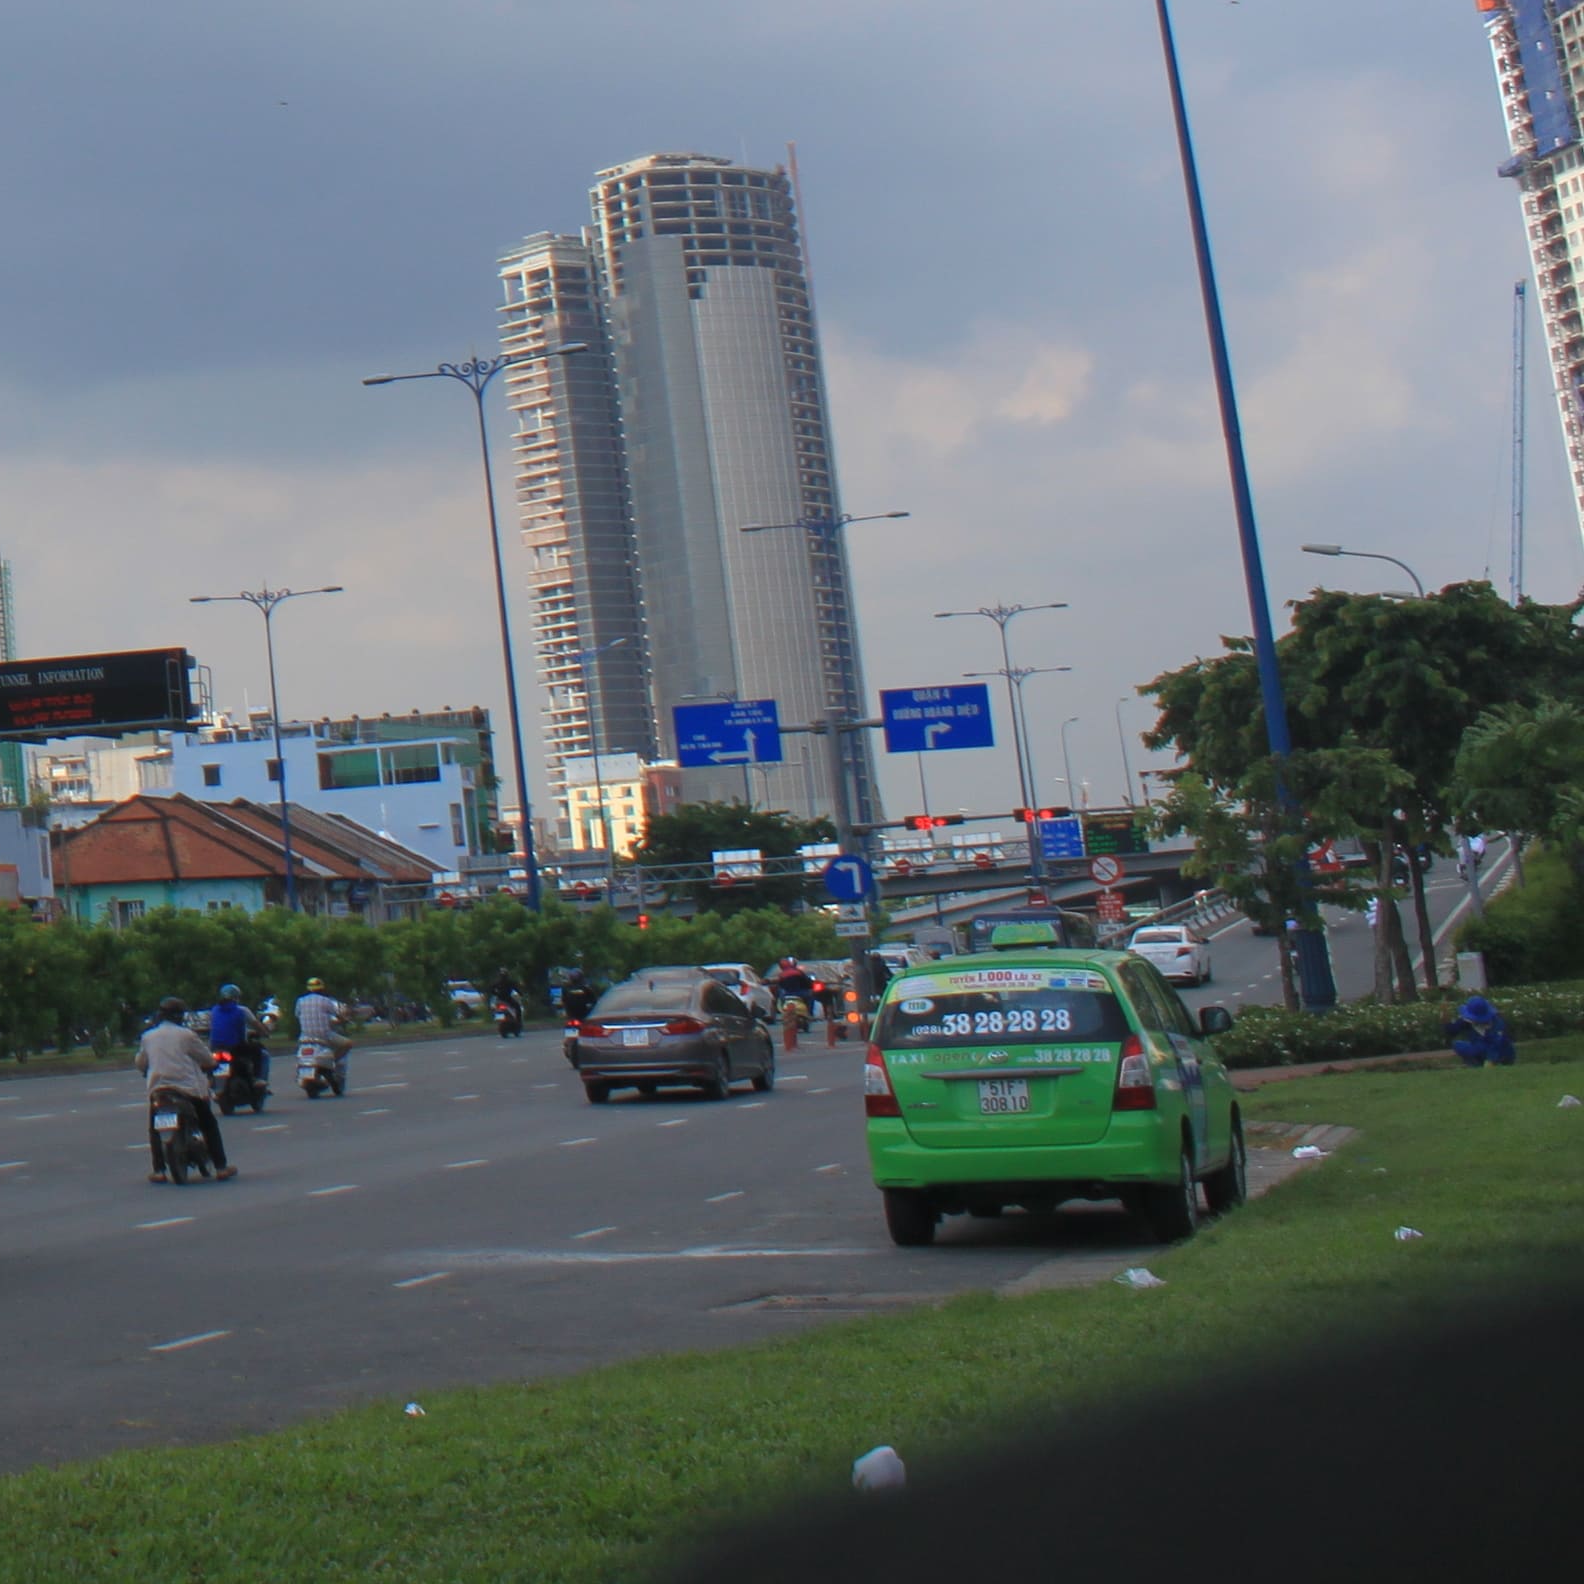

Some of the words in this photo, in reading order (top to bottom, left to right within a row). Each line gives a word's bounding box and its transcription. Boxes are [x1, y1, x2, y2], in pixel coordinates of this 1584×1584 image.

[38, 667, 105, 685] INFORMATION
[978, 971, 1013, 983] 1.000
[941, 1014, 971, 1036] 38
[974, 1011, 1003, 1033] 28
[1007, 1010, 1036, 1032] 28
[1040, 1009, 1071, 1031] 28
[889, 1053, 925, 1064] TAXI
[1055, 1049, 1072, 1062] 28
[1073, 1049, 1091, 1062] 28
[1093, 1048, 1112, 1062] 28
[989, 1081, 1016, 1096] 51F
[981, 1096, 1029, 1113] 308.10
